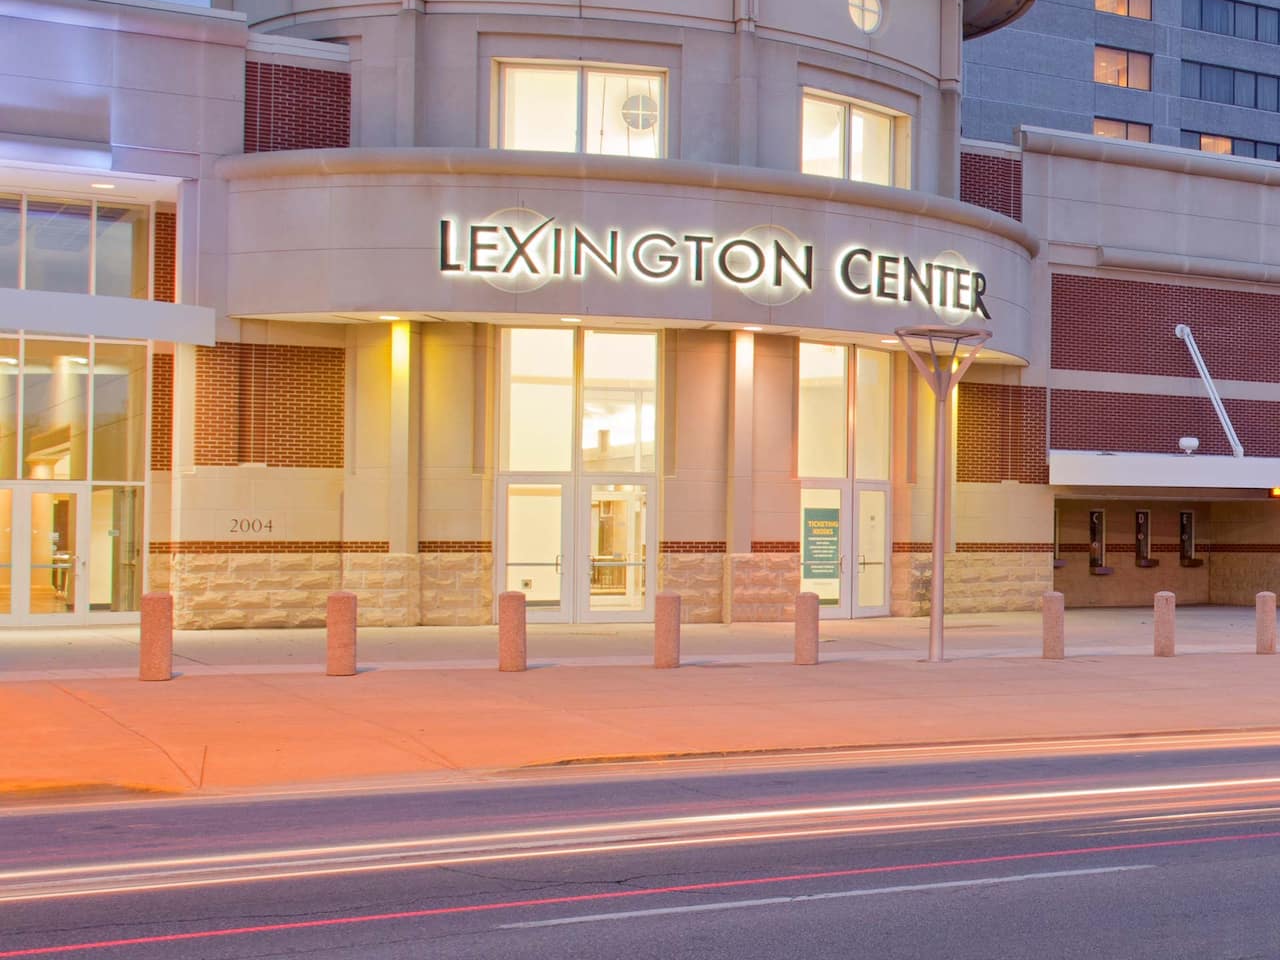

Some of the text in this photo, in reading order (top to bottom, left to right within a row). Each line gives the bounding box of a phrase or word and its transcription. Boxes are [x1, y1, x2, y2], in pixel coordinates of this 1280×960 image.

[440, 216, 992, 320] LEXINGTON CENTER
[229, 518, 273, 533] 2004
